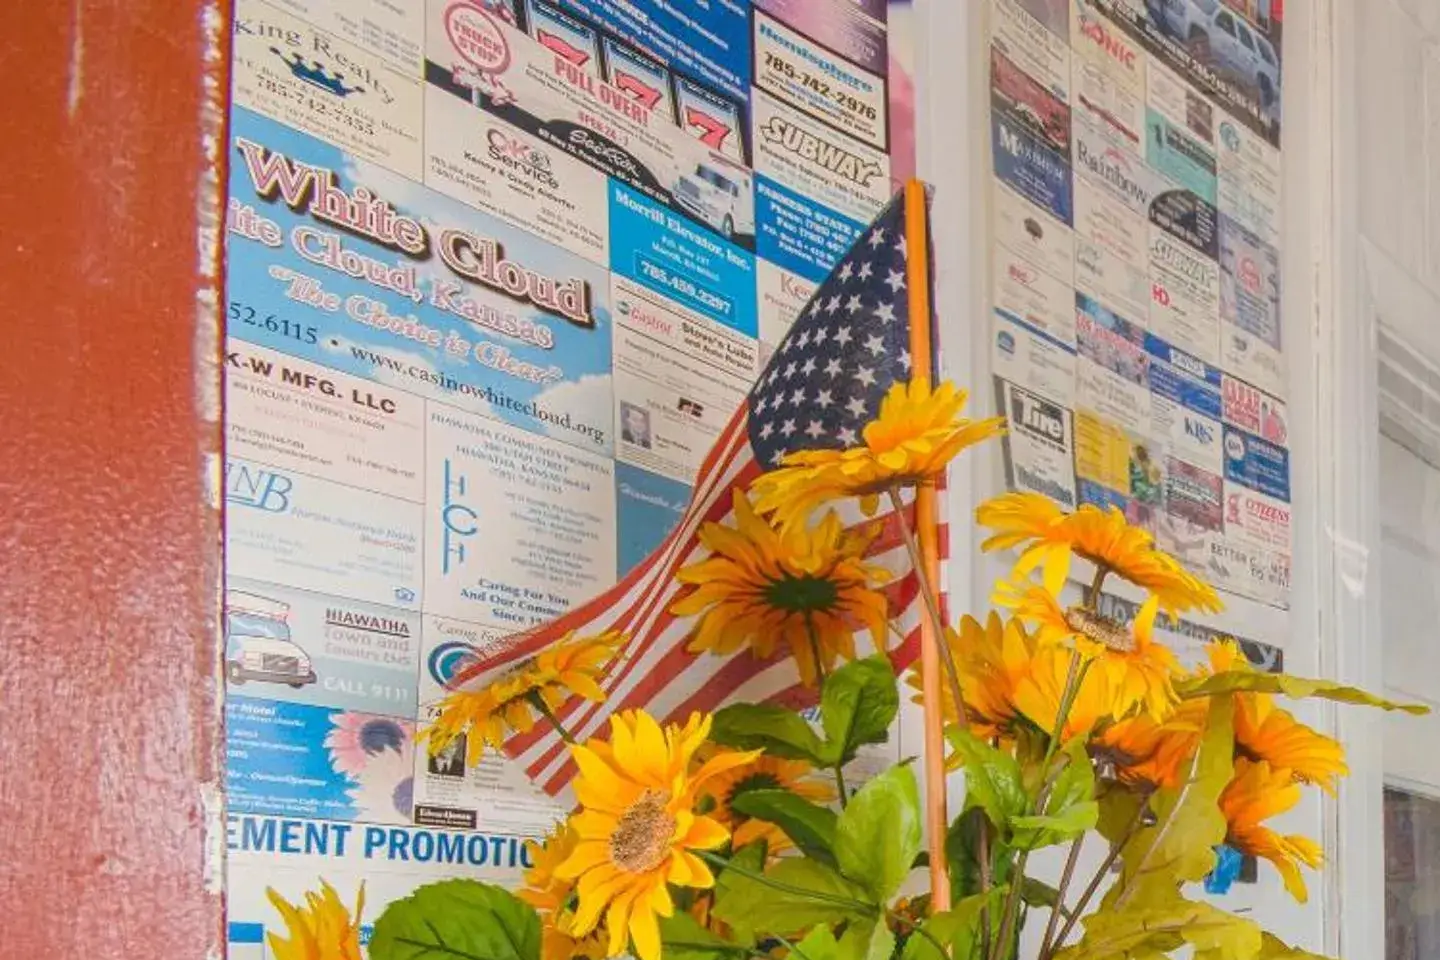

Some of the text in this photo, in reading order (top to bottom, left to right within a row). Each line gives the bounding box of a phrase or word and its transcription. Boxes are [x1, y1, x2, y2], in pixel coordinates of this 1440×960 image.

[452, 22, 504, 57] TRUCK
[457, 38, 502, 67] STOP
[314, 36, 396, 104] Realty
[554, 55, 596, 98] PULL
[599, 83, 648, 125] OVER!
[763, 51, 877, 120] 785-742-2976
[487, 145, 560, 189] Service
[760, 116, 884, 189] SUBWAY
[1076, 138, 1148, 206] Rainbow
[235, 137, 436, 260] White
[439, 226, 600, 335] Cloud
[226, 200, 556, 354] ite Cloud, Kansas
[226, 303, 319, 348] 52.6115
[349, 346, 606, 447] www.casinowhitecloud.org
[282, 366, 344, 399] MFG.
[352, 389, 397, 415] LLC
[225, 463, 293, 513] NB
[460, 588, 516, 610] And Our
[479, 575, 571, 608] Caring For You
[324, 625, 411, 654] Town and
[325, 607, 411, 634] HIAWATHA
[324, 676, 368, 699] CALL
[226, 815, 352, 858] EMENT
